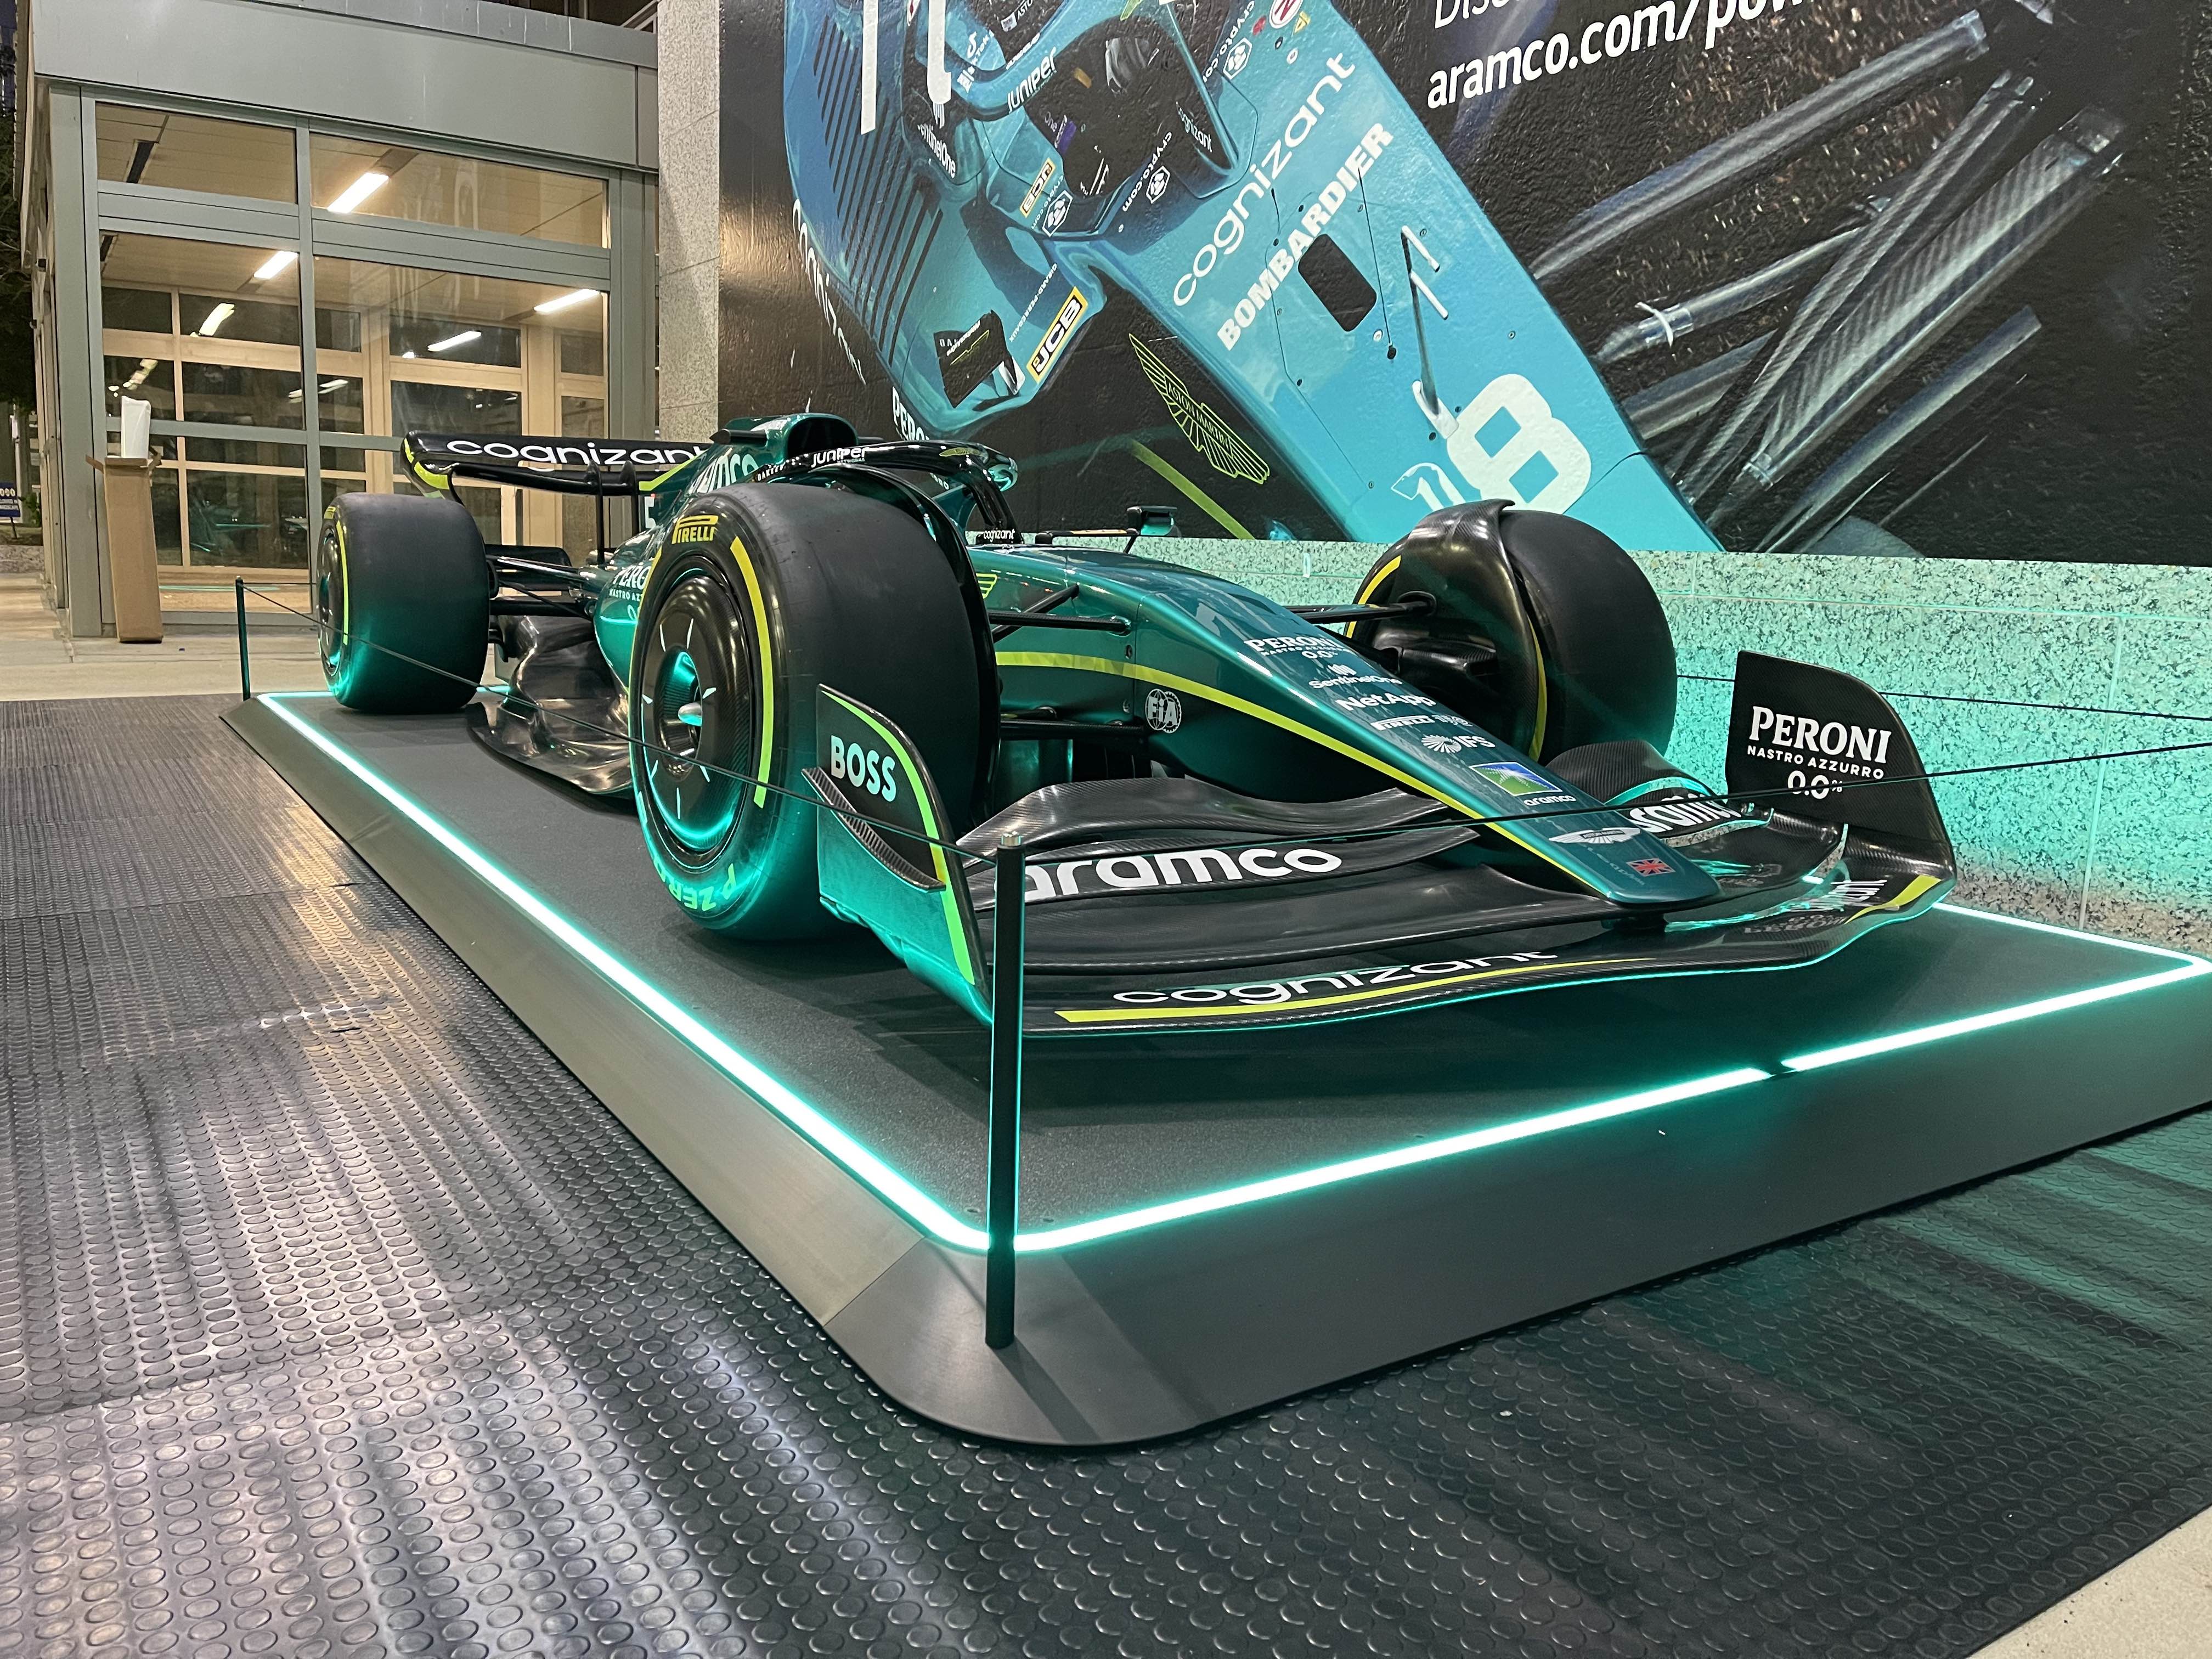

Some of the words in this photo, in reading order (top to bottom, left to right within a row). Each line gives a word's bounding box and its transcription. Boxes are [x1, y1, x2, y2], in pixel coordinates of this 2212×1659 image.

[917, 123, 956, 178] entinelOne
[1173, 53, 1356, 306] cognizant
[1217, 123, 1393, 351] BOMBARDIER
[1032, 298, 1081, 373] JCB
[893, 386, 929, 441] PER
[672, 515, 719, 544] PIRELLI
[1335, 692, 1437, 711] NetApp
[1748, 706, 1892, 764] PERONI
[830, 735, 897, 802] BOSS
[1747, 745, 1804, 765] NASTRO
[1808, 757, 1884, 780] AZZURRO
[1787, 770, 1843, 799] 0.0%
[1523, 795, 1577, 806] aramco
[994, 848, 1342, 901] aramco
[1113, 951, 1558, 1005] cognizant
